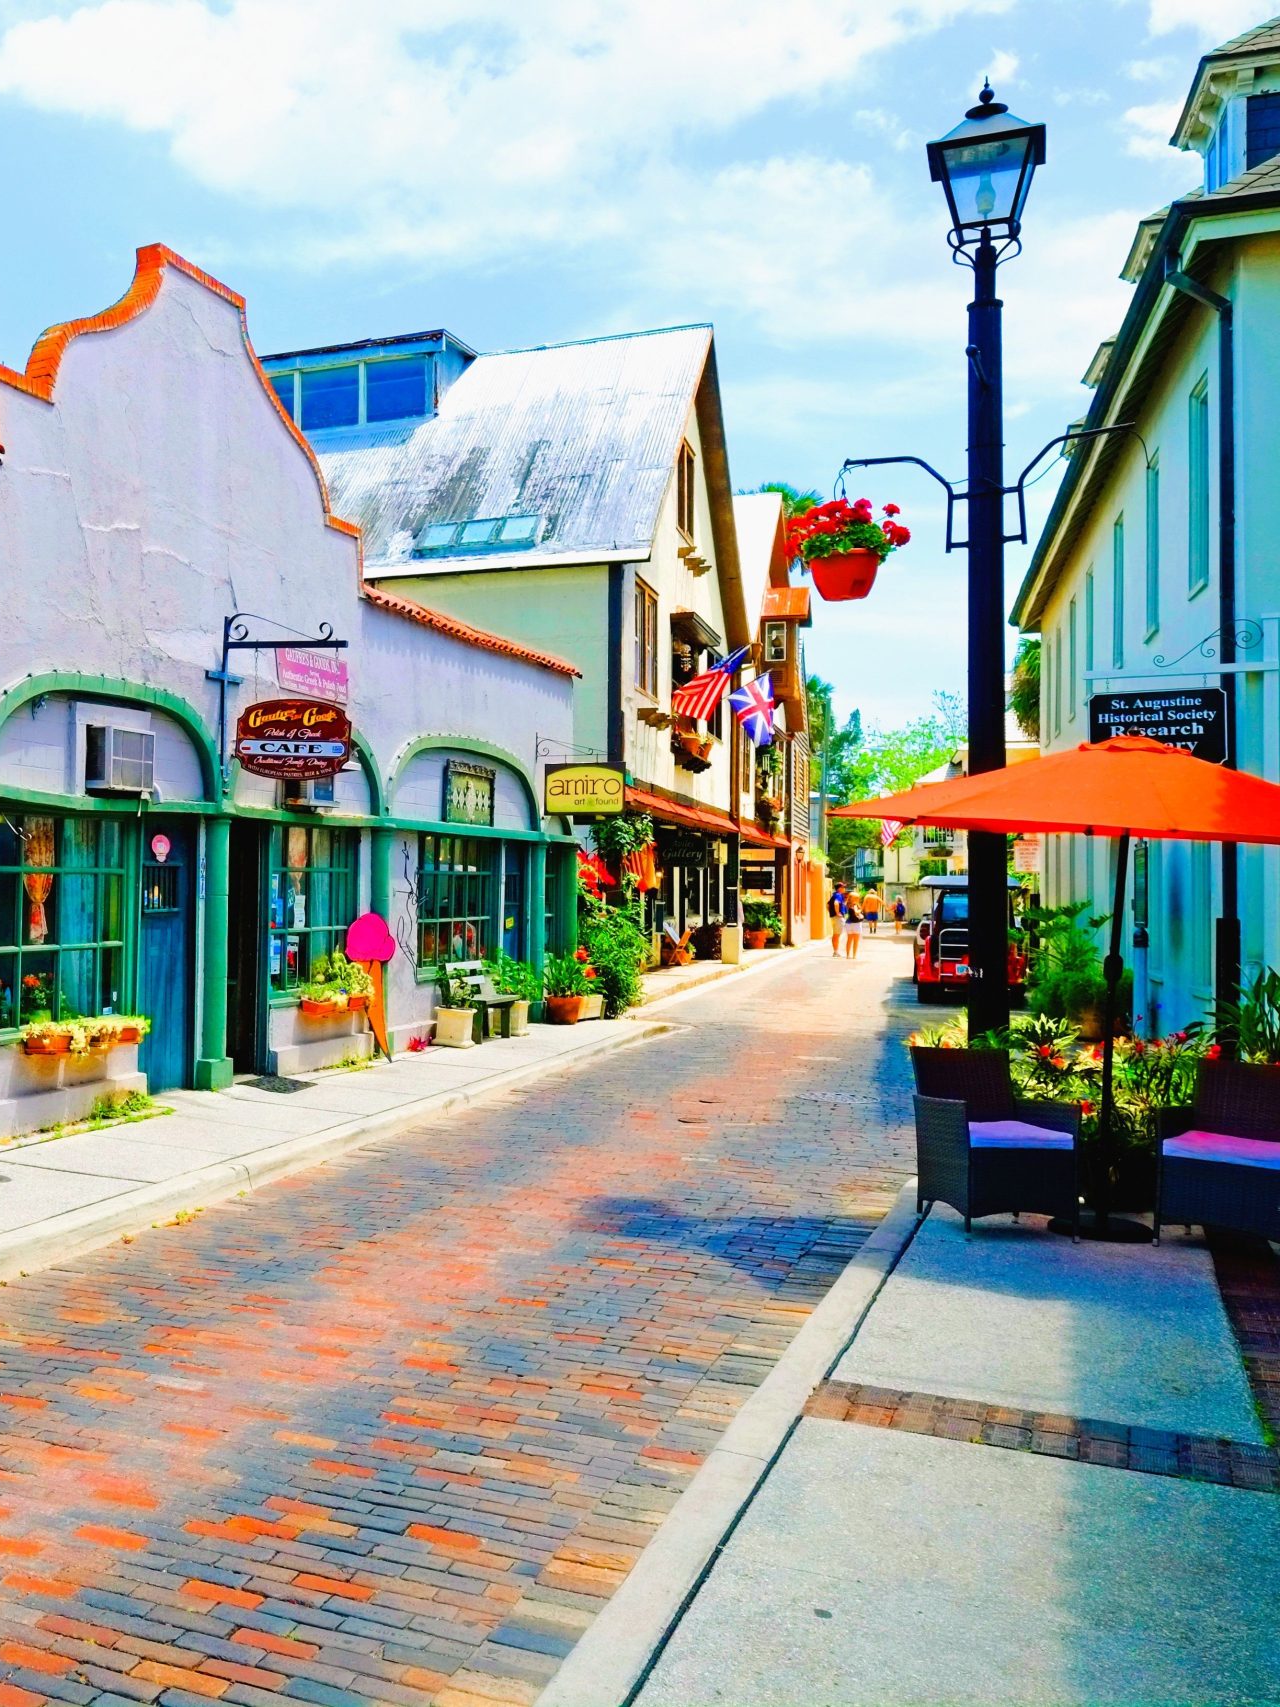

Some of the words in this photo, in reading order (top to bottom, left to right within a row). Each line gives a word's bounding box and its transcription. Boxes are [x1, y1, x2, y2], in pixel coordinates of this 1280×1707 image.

[1111, 699, 1129, 710] St.
[1132, 696, 1202, 710] Augustine
[248, 708, 297, 728] Gaufres
[302, 707, 337, 727] Goods
[1097, 710, 1164, 724] Historical
[1167, 709, 1217, 722] Society
[1110, 722, 1204, 738] Rsearch
[259, 743, 323, 754] CAFE
[549, 775, 621, 796] amiro
[574, 797, 585, 806] art
[595, 797, 619, 806] found
